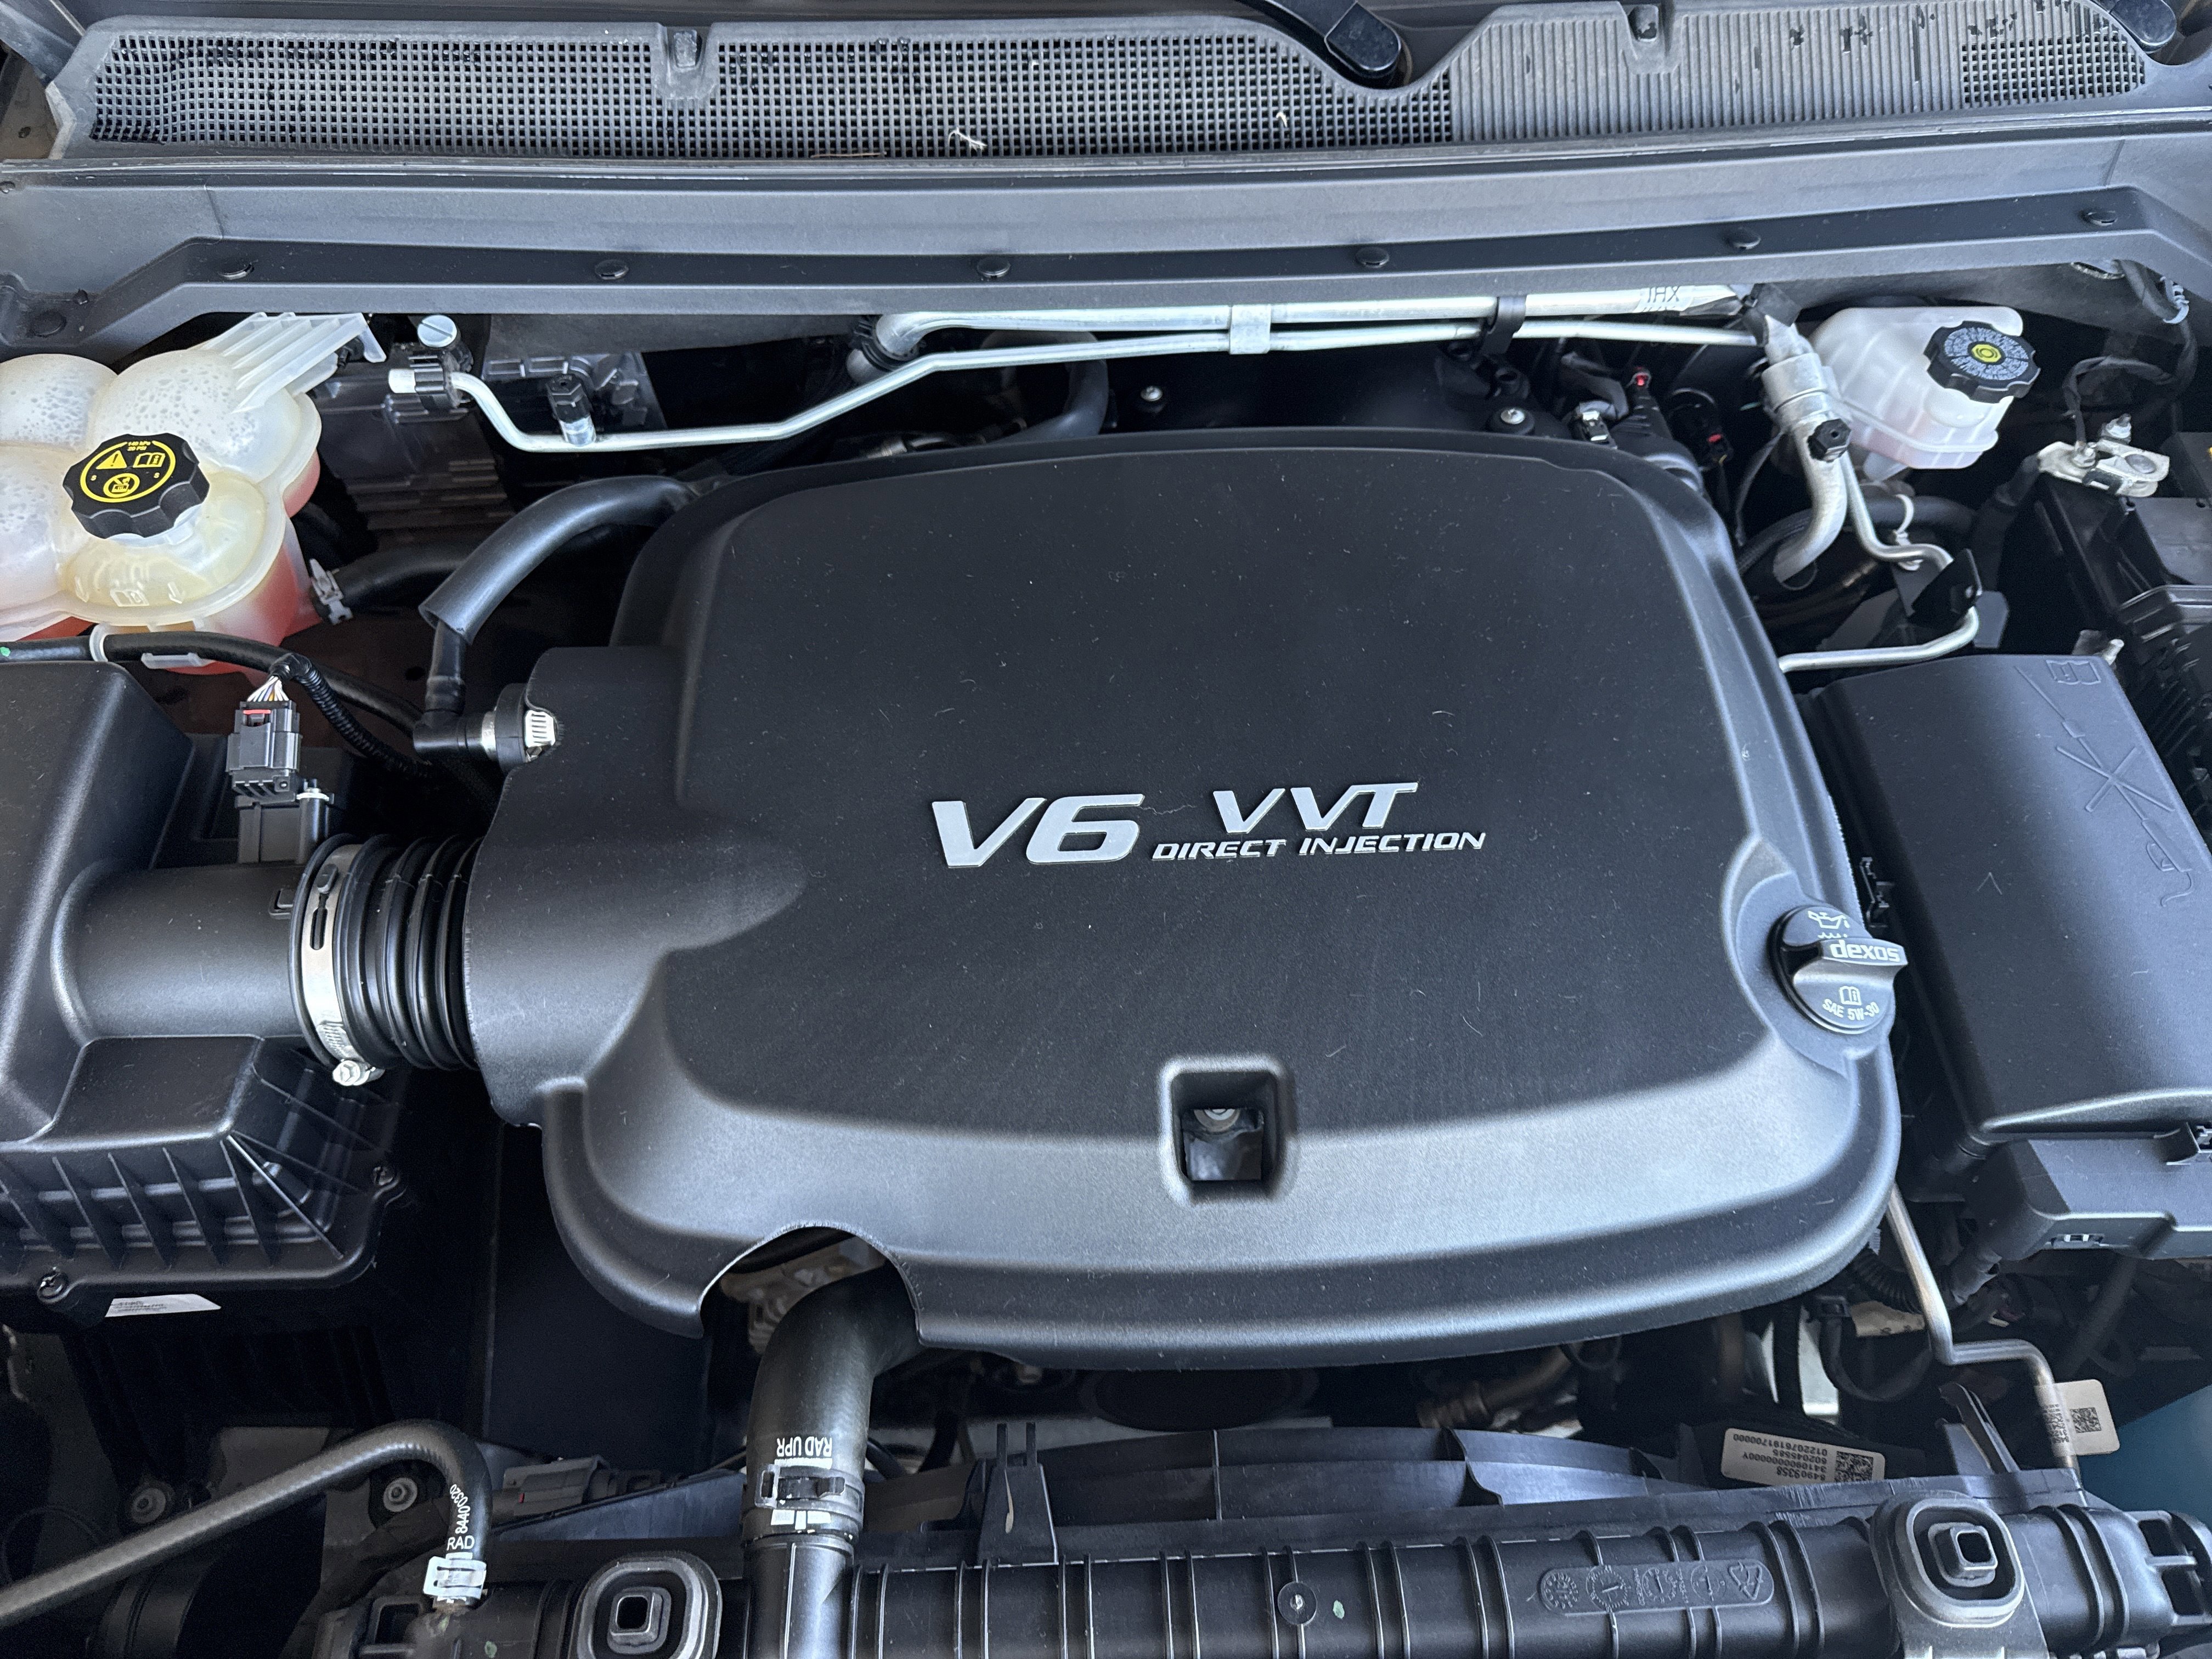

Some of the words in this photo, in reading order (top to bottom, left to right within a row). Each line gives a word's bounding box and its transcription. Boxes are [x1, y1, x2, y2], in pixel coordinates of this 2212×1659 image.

[1212, 782, 1418, 833] VVT
[932, 793, 1144, 868] V6
[1152, 839, 1285, 861] DIRECT
[1298, 832, 1486, 856] INJECTION
[1830, 940, 1900, 962] dexos
[1822, 998, 1844, 1018] SAE
[1847, 1002, 1880, 1020] 5W-30
[776, 1436, 802, 1457] UPR
[805, 1436, 832, 1457] RAD
[450, 1484, 471, 1534] 84400320
[447, 1535, 475, 1550] RAD
